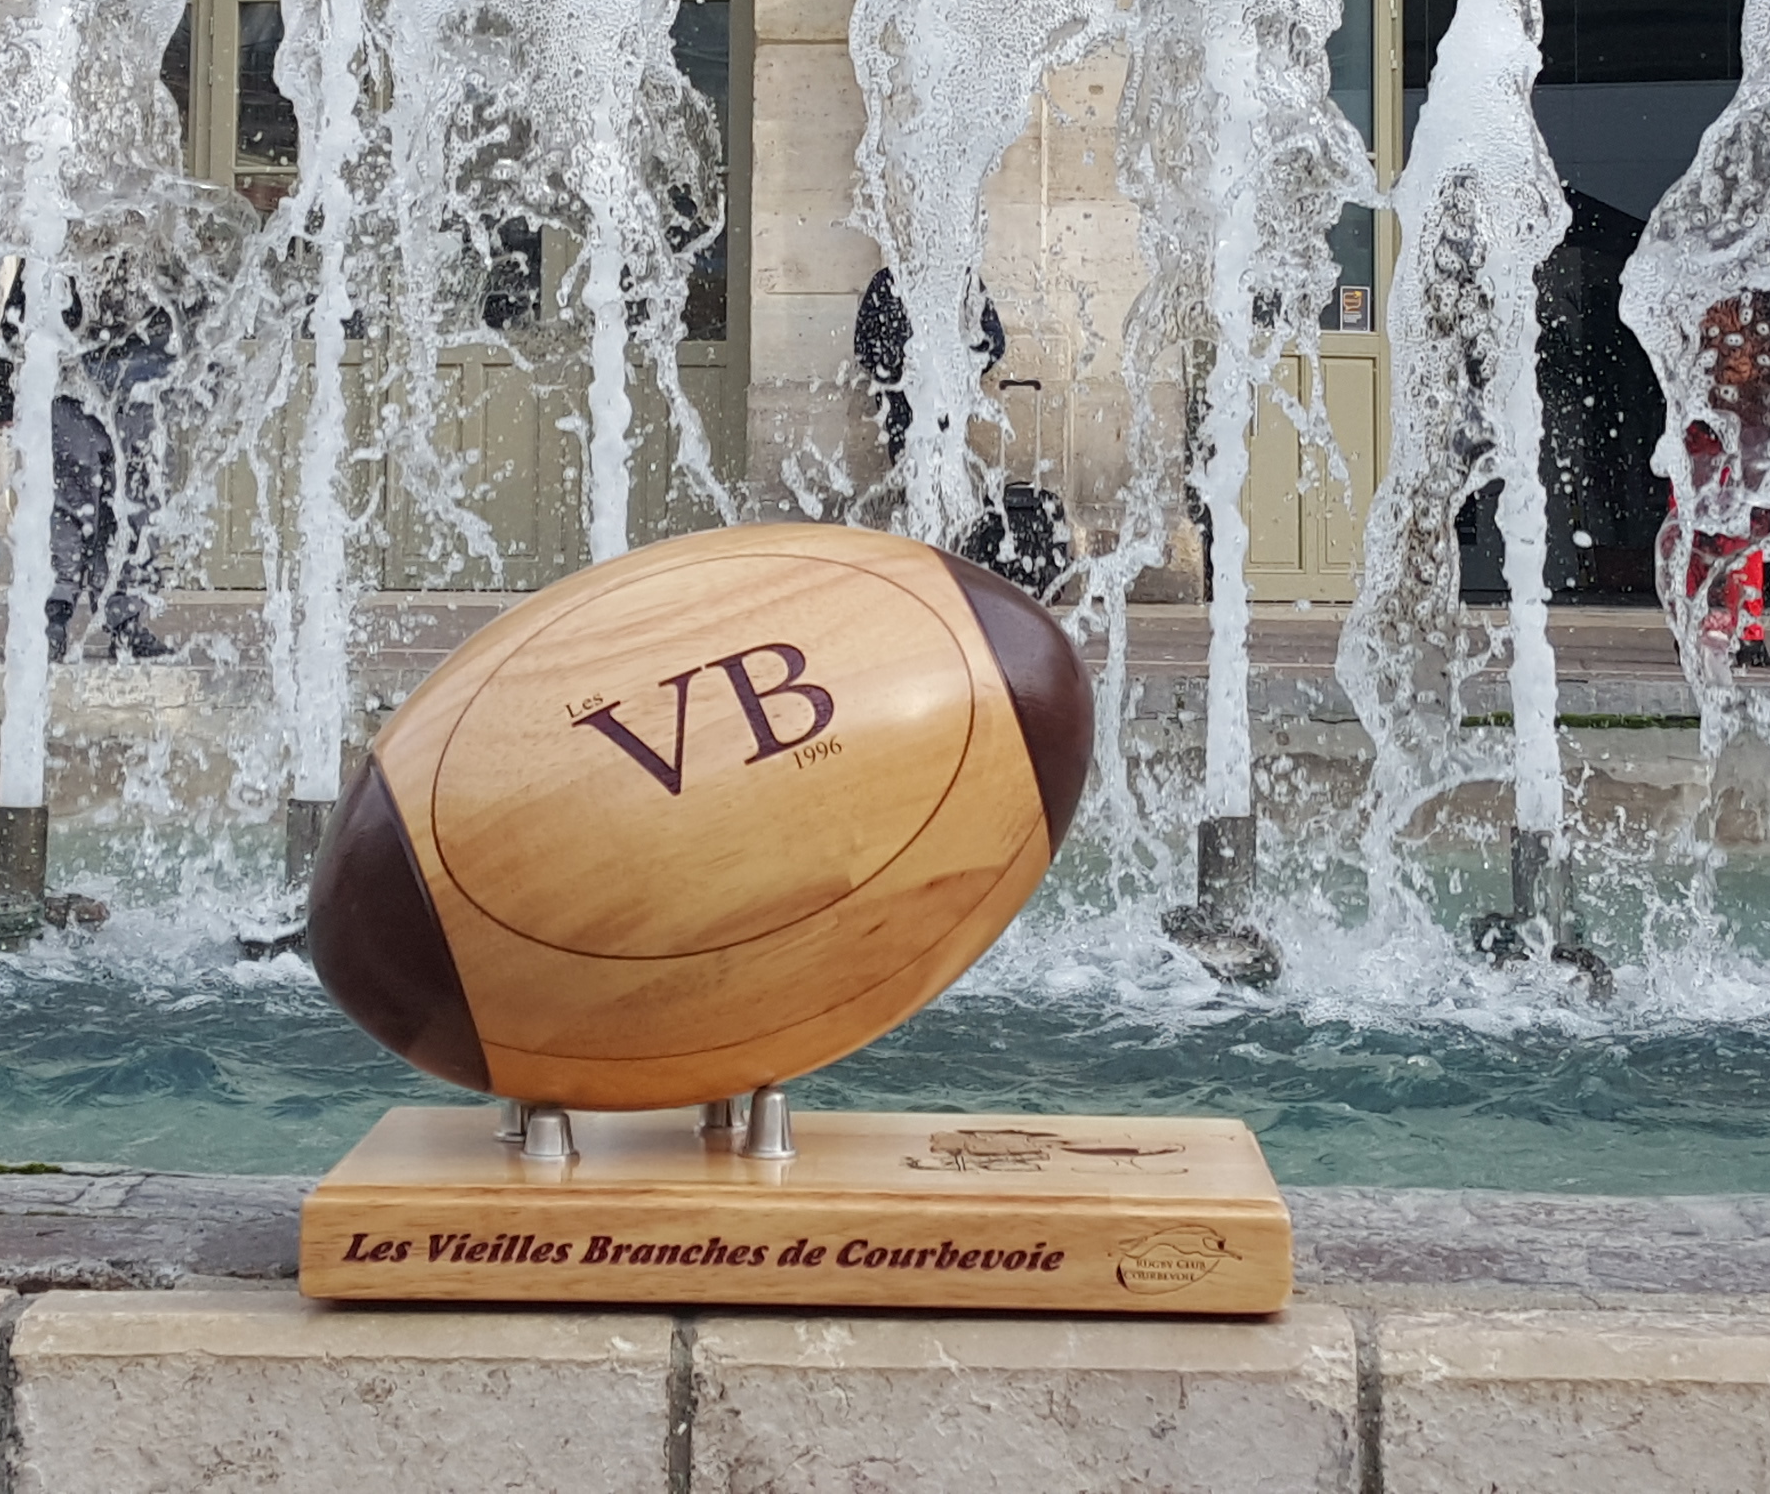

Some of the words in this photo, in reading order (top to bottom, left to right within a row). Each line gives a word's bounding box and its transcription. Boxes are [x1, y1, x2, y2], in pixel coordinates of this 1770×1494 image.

[566, 692, 604, 719] Les
[571, 643, 835, 797] VB
[791, 737, 843, 770] 1996
[341, 1233, 412, 1264] Les
[427, 1233, 573, 1265] Vieilles
[579, 1235, 769, 1267] Branches
[777, 1238, 827, 1267] de
[835, 1238, 1066, 1271] Courbevoie
